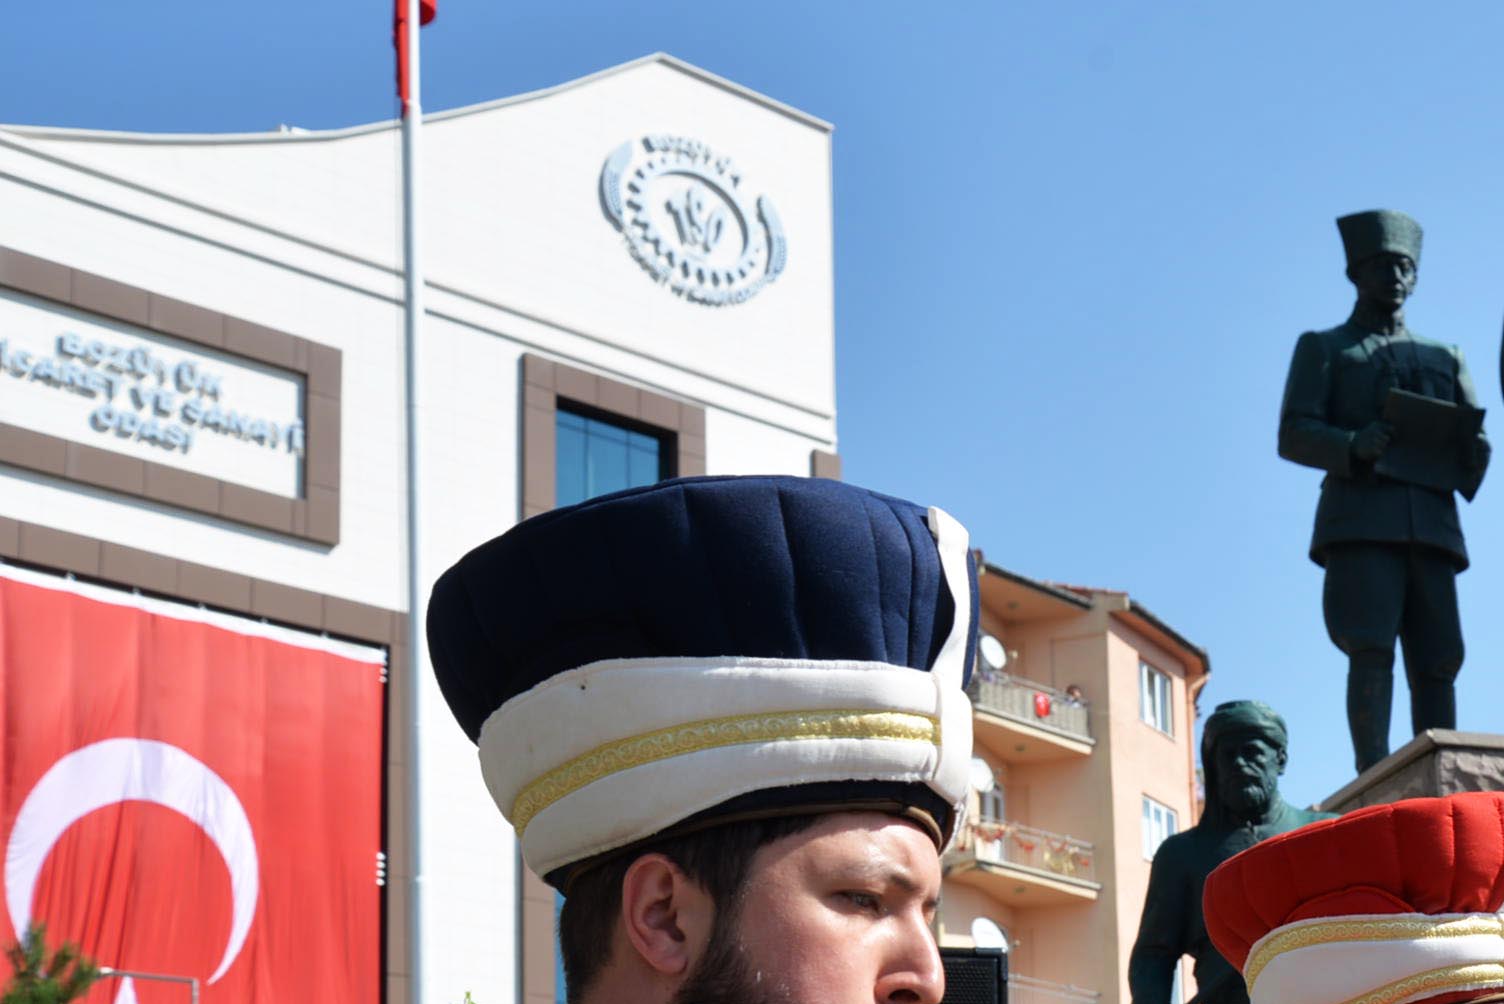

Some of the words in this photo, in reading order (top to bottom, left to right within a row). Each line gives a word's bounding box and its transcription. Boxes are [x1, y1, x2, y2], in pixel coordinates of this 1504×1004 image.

[0, 335, 122, 402] İCARET
[128, 384, 176, 418] VE
[88, 403, 195, 455] ODASI
